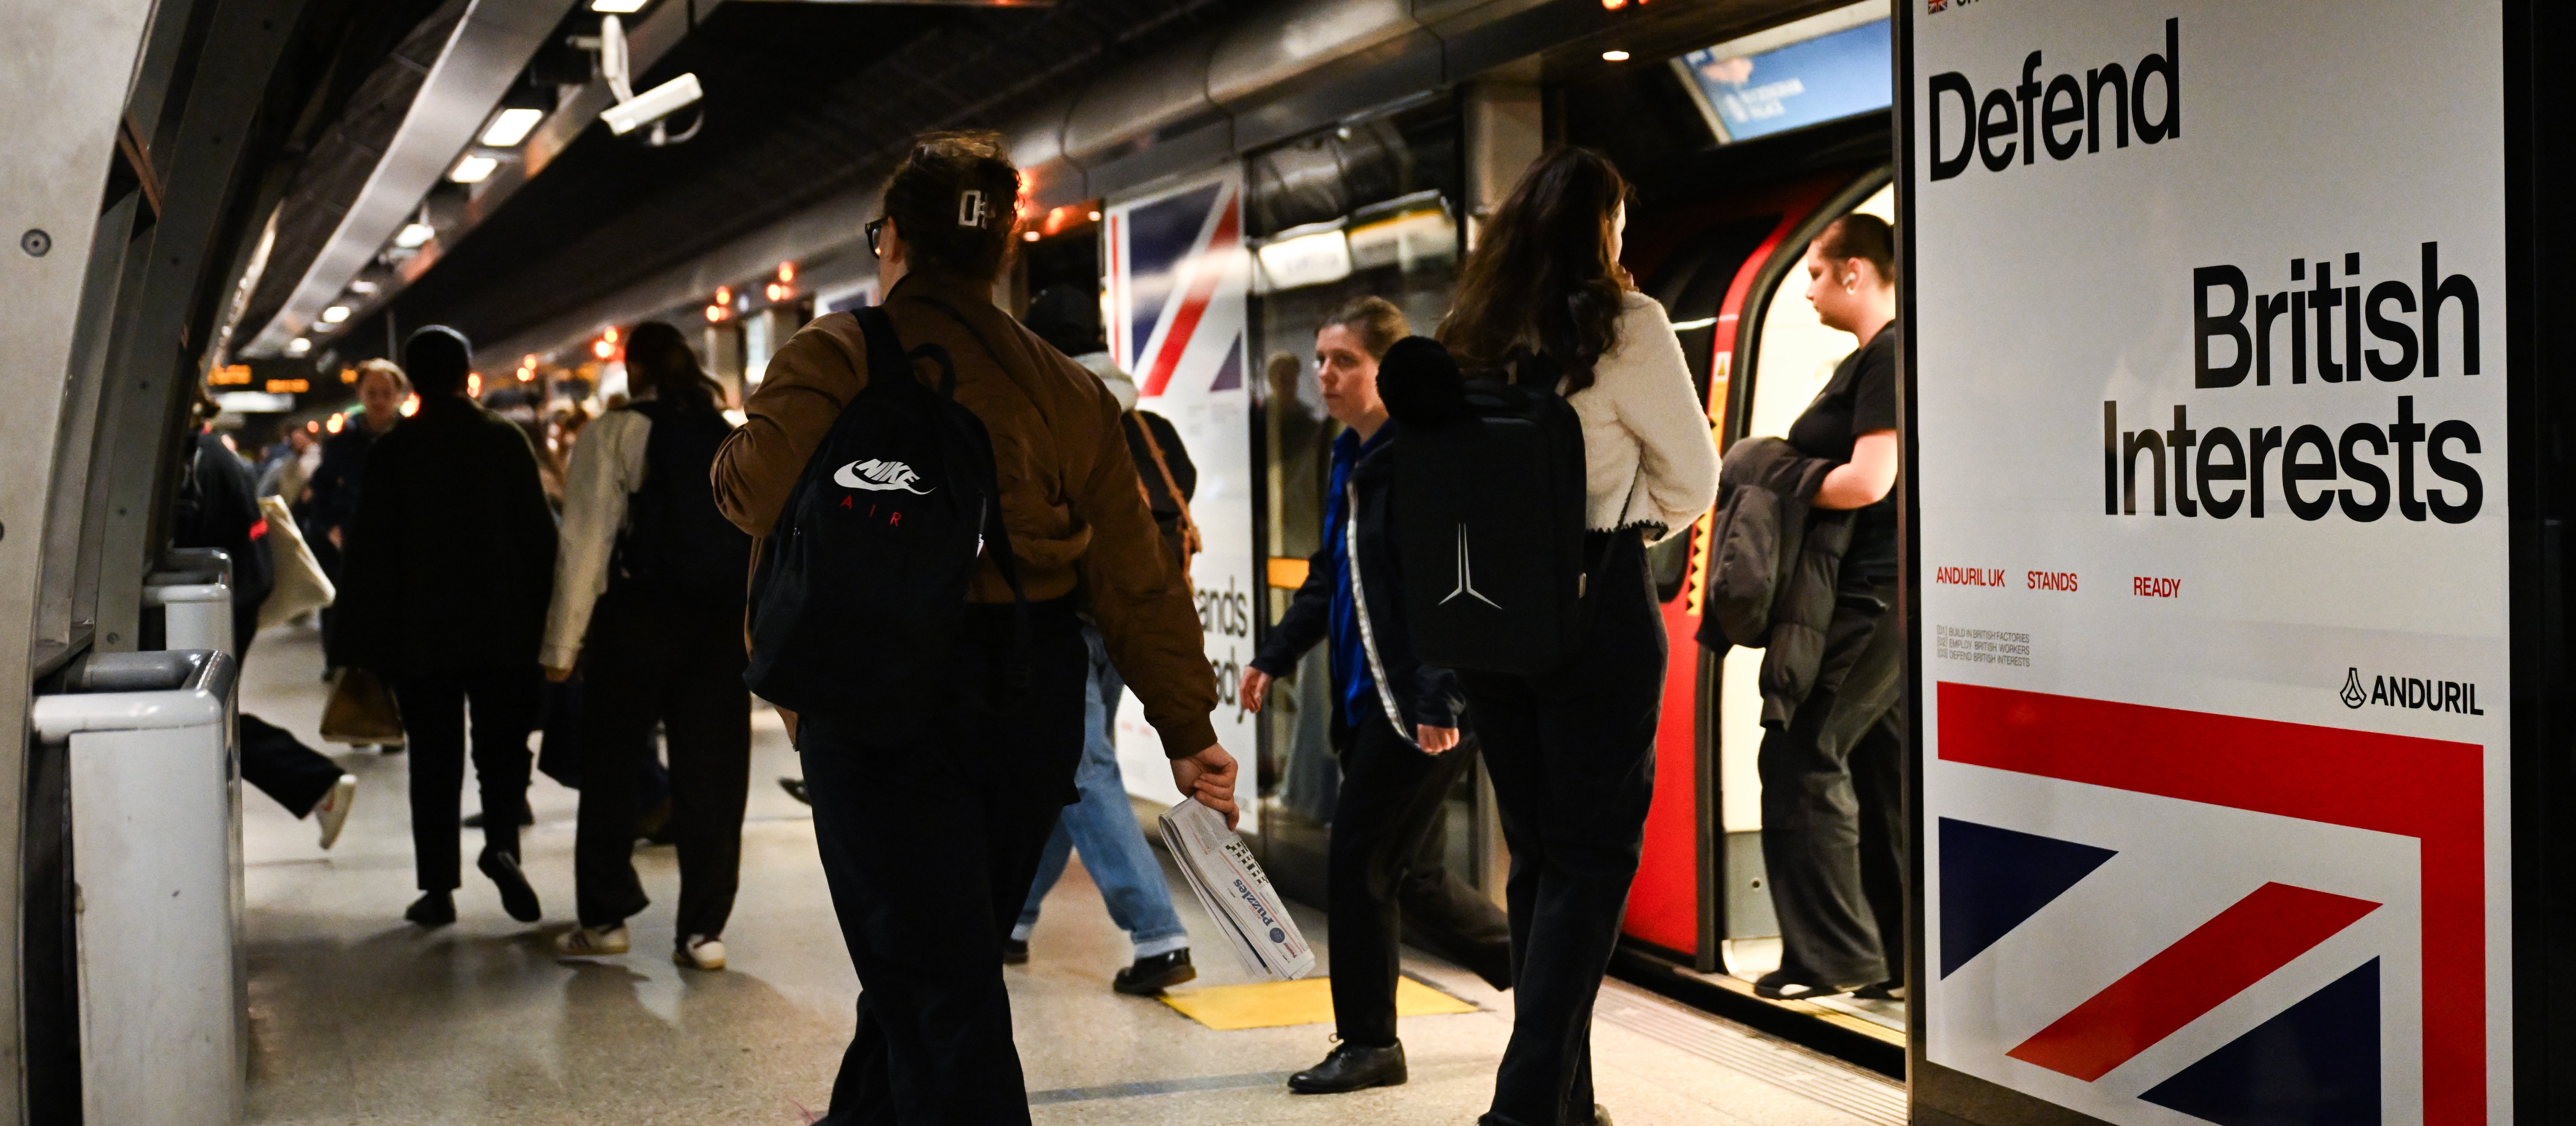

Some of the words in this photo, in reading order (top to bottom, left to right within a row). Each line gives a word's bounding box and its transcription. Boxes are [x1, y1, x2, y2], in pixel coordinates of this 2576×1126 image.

[1930, 17, 2181, 182] Defend
[2193, 241, 2480, 389] British
[855, 458, 921, 485] NIKE
[2104, 395, 2483, 524] Interests
[840, 495, 902, 527] AIR
[1937, 566, 1986, 586] ANDURIL
[1988, 569, 2006, 587] UK
[2027, 570, 2078, 592] STANDS
[2134, 576, 2181, 599] READY
[1197, 575, 1248, 638] ands
[1949, 627, 1966, 637] BUILD
[1967, 628, 1973, 638] IN
[1973, 629, 1996, 640] BRITISH
[1996, 631, 2030, 643] FACTORIES
[1949, 639, 1973, 650] EMPLOY
[1974, 641, 1997, 652] BRITISH
[1999, 643, 2030, 655] WORKERS
[1949, 650, 1972, 661] DEFEND
[1973, 652, 1996, 663] BRITISH
[1997, 655, 2030, 667] INTERESTS
[2371, 675, 2484, 716] ANDURIL
[1233, 879, 1274, 927] Puzzles
